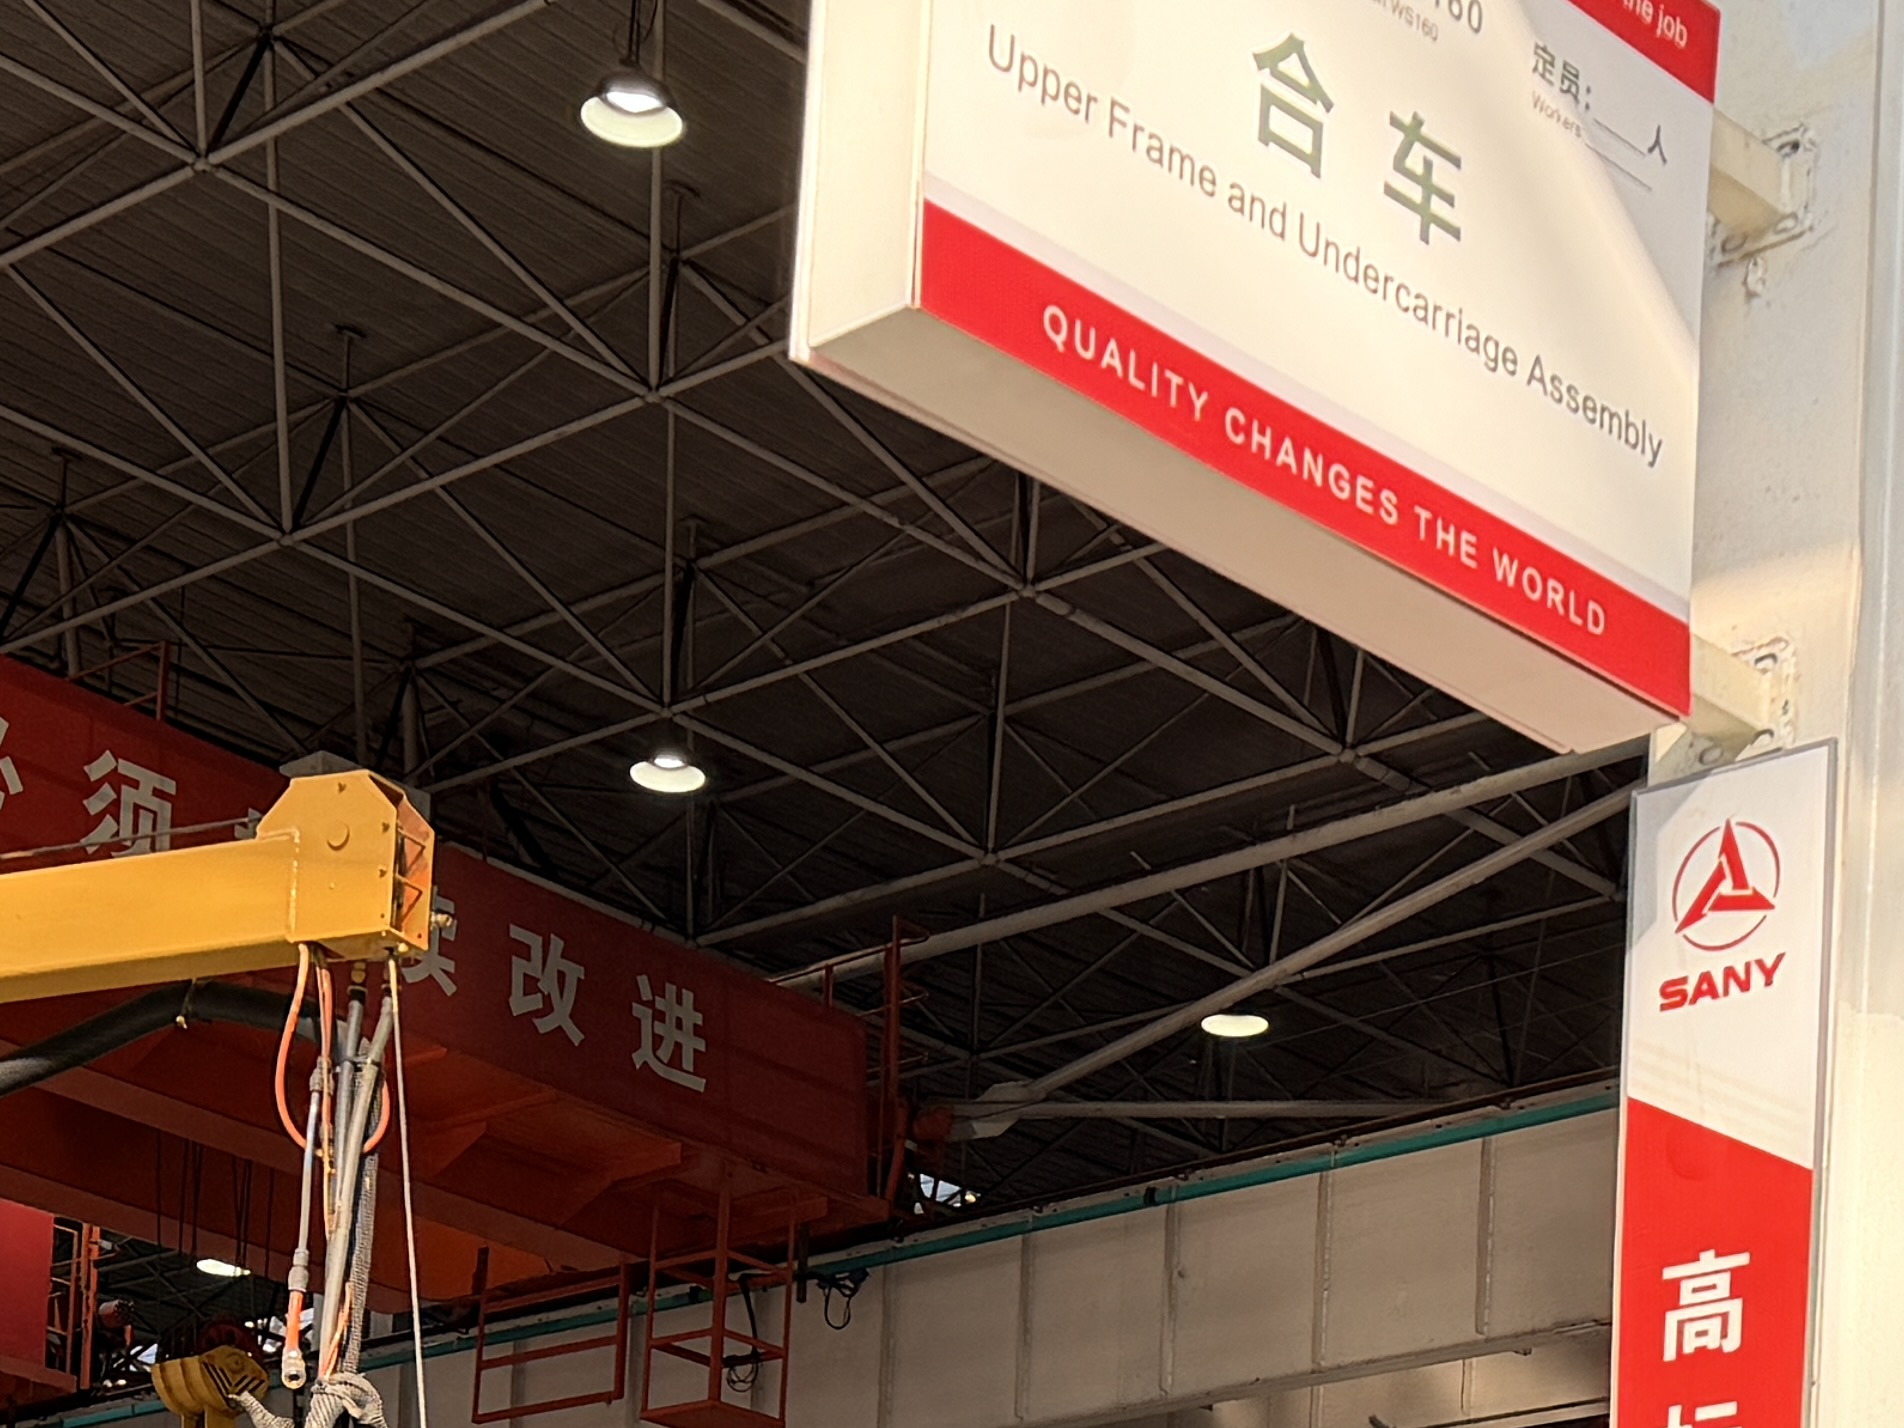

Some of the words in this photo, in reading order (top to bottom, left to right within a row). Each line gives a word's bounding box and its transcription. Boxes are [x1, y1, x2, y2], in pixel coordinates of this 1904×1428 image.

[1434, 0, 1483, 34] 60
[1656, 4, 1688, 49] job
[1252, 33, 1463, 245] 合车
[1647, 124, 1668, 165] 人
[988, 23, 1099, 125] Upper
[1108, 96, 1218, 199] Frame
[1227, 181, 1288, 242] and
[1298, 211, 1519, 378] Undercarriage
[1526, 353, 1664, 468] Assembly
[1042, 304, 1209, 421] QUALITY
[1224, 407, 1399, 527] CHANGES
[1414, 505, 1479, 569] THE
[1492, 546, 1607, 637] WORLD
[1659, 951, 1786, 1013] SANY
